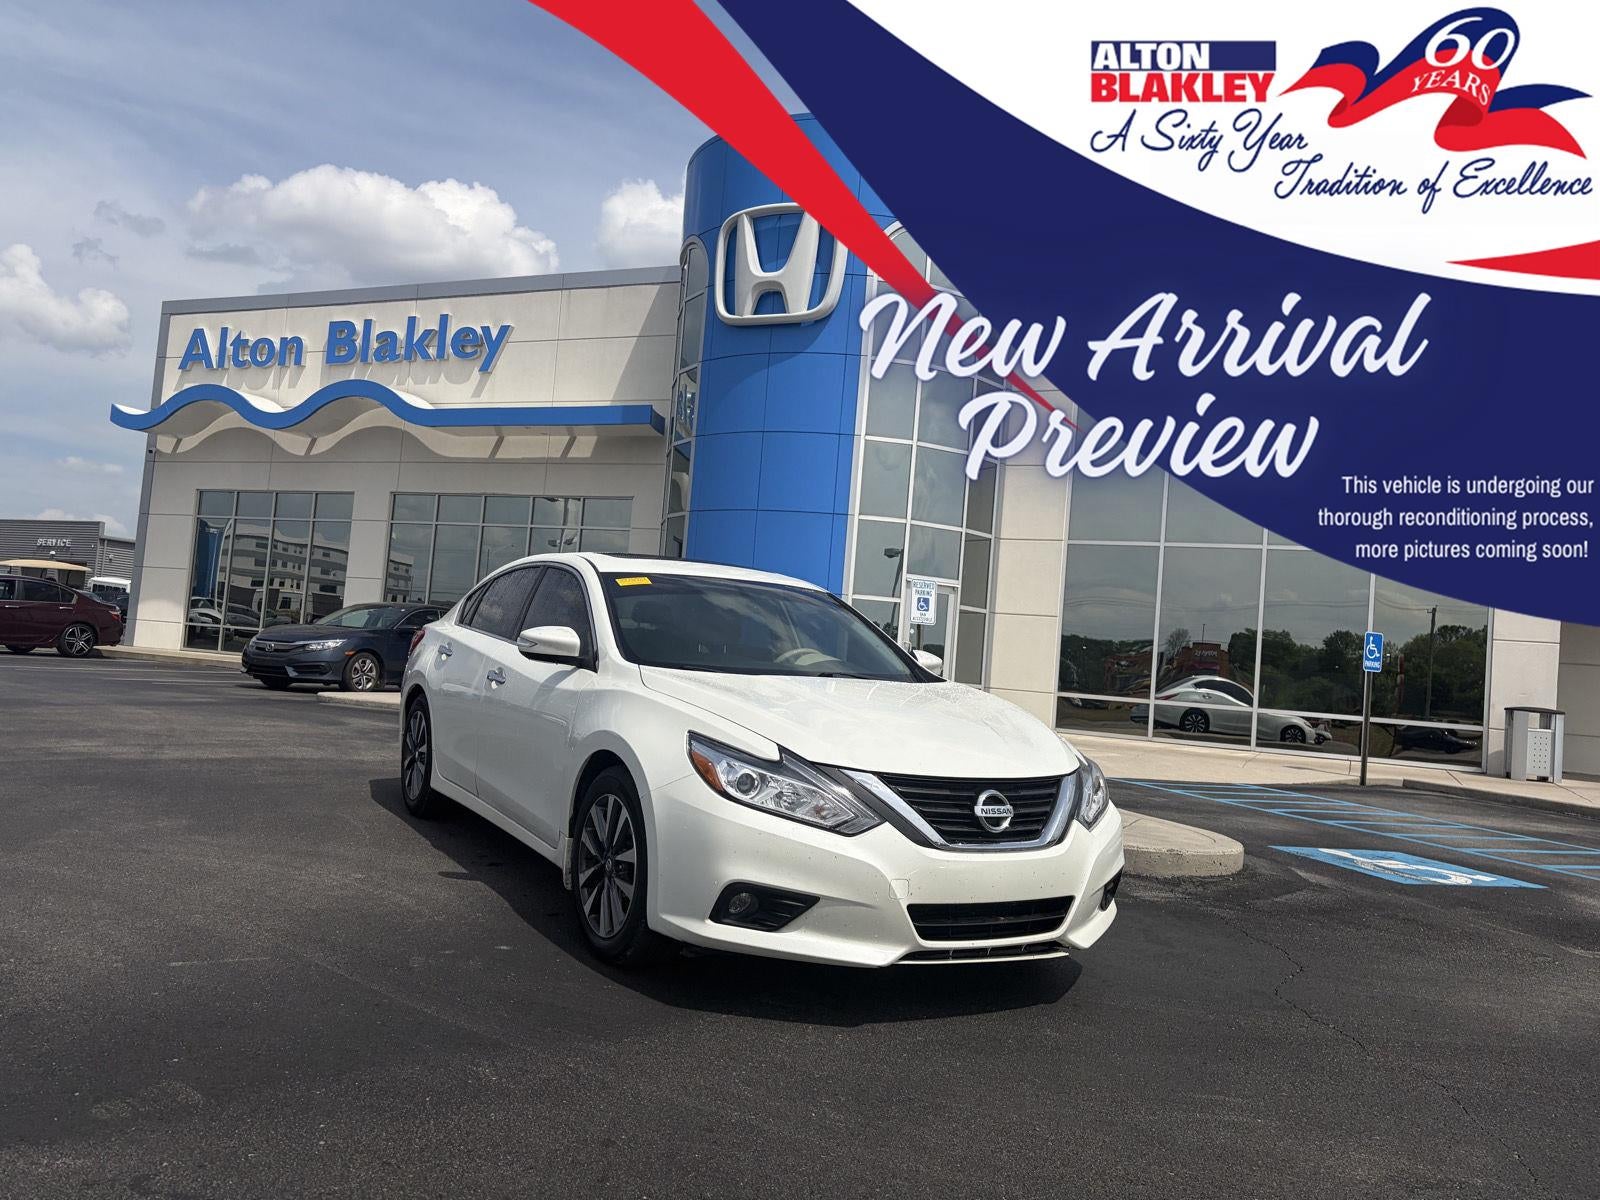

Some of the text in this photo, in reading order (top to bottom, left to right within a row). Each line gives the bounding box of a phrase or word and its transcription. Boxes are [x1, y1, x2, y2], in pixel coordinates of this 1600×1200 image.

[178, 313, 514, 374] Alton Blakley
[36, 538, 72, 547] SERVICE
[914, 589, 933, 597] PARKING
[980, 807, 1012, 815] NISSAN
